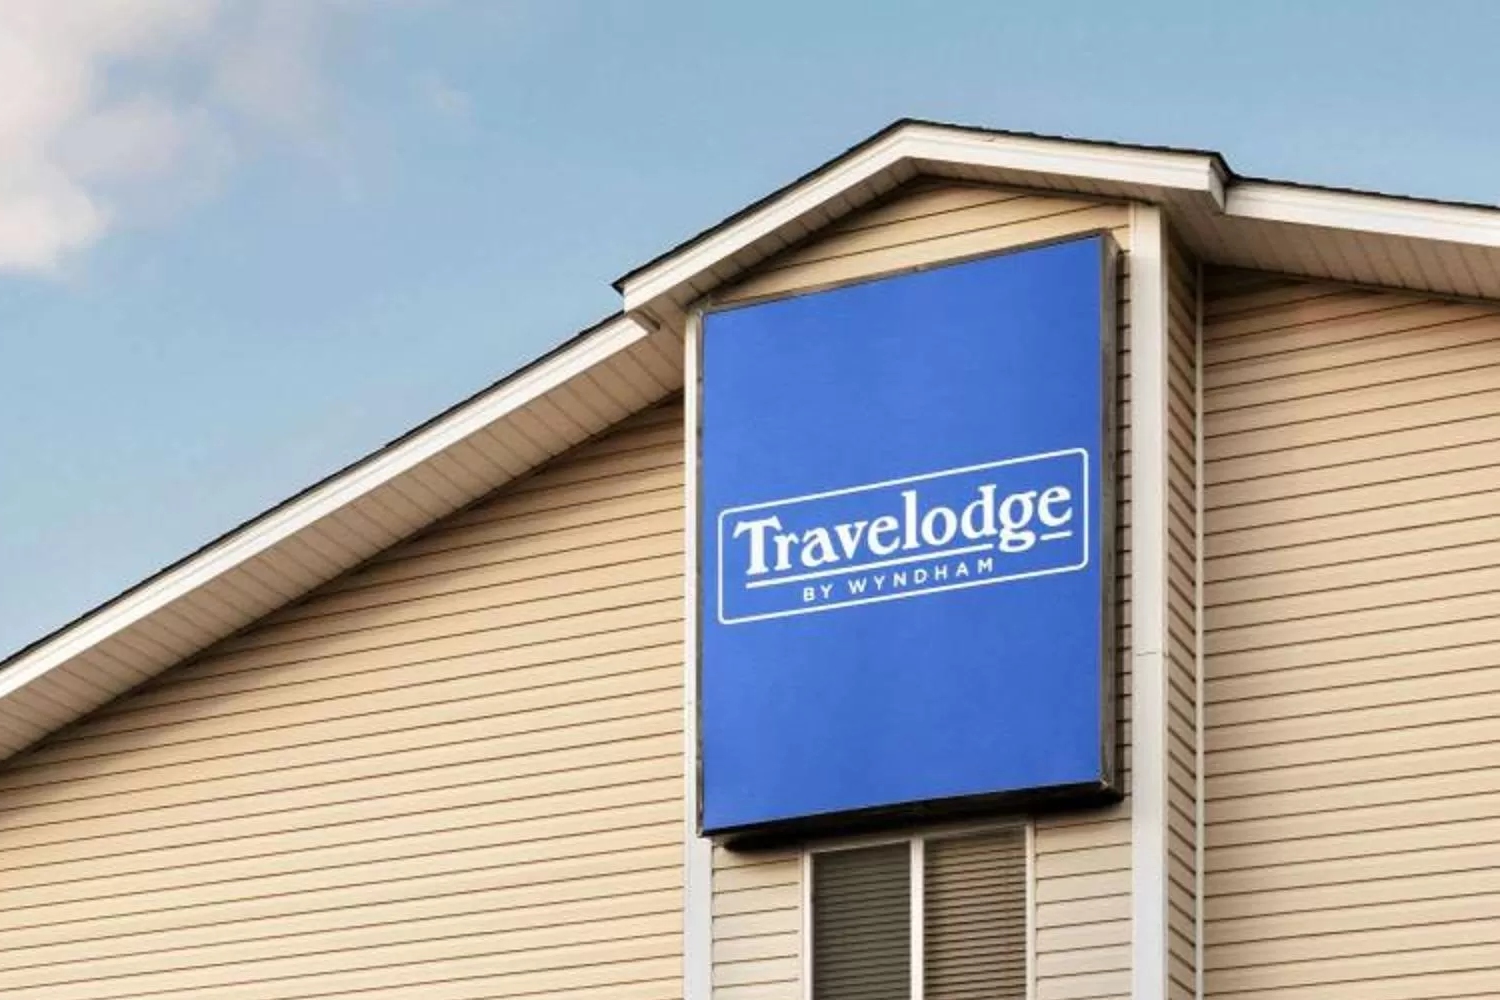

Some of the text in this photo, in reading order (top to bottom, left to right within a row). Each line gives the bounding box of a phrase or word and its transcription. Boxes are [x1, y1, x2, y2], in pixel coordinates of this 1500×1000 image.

[733, 484, 1073, 576] Travelodge
[803, 557, 994, 602] BY WYNDHAM
